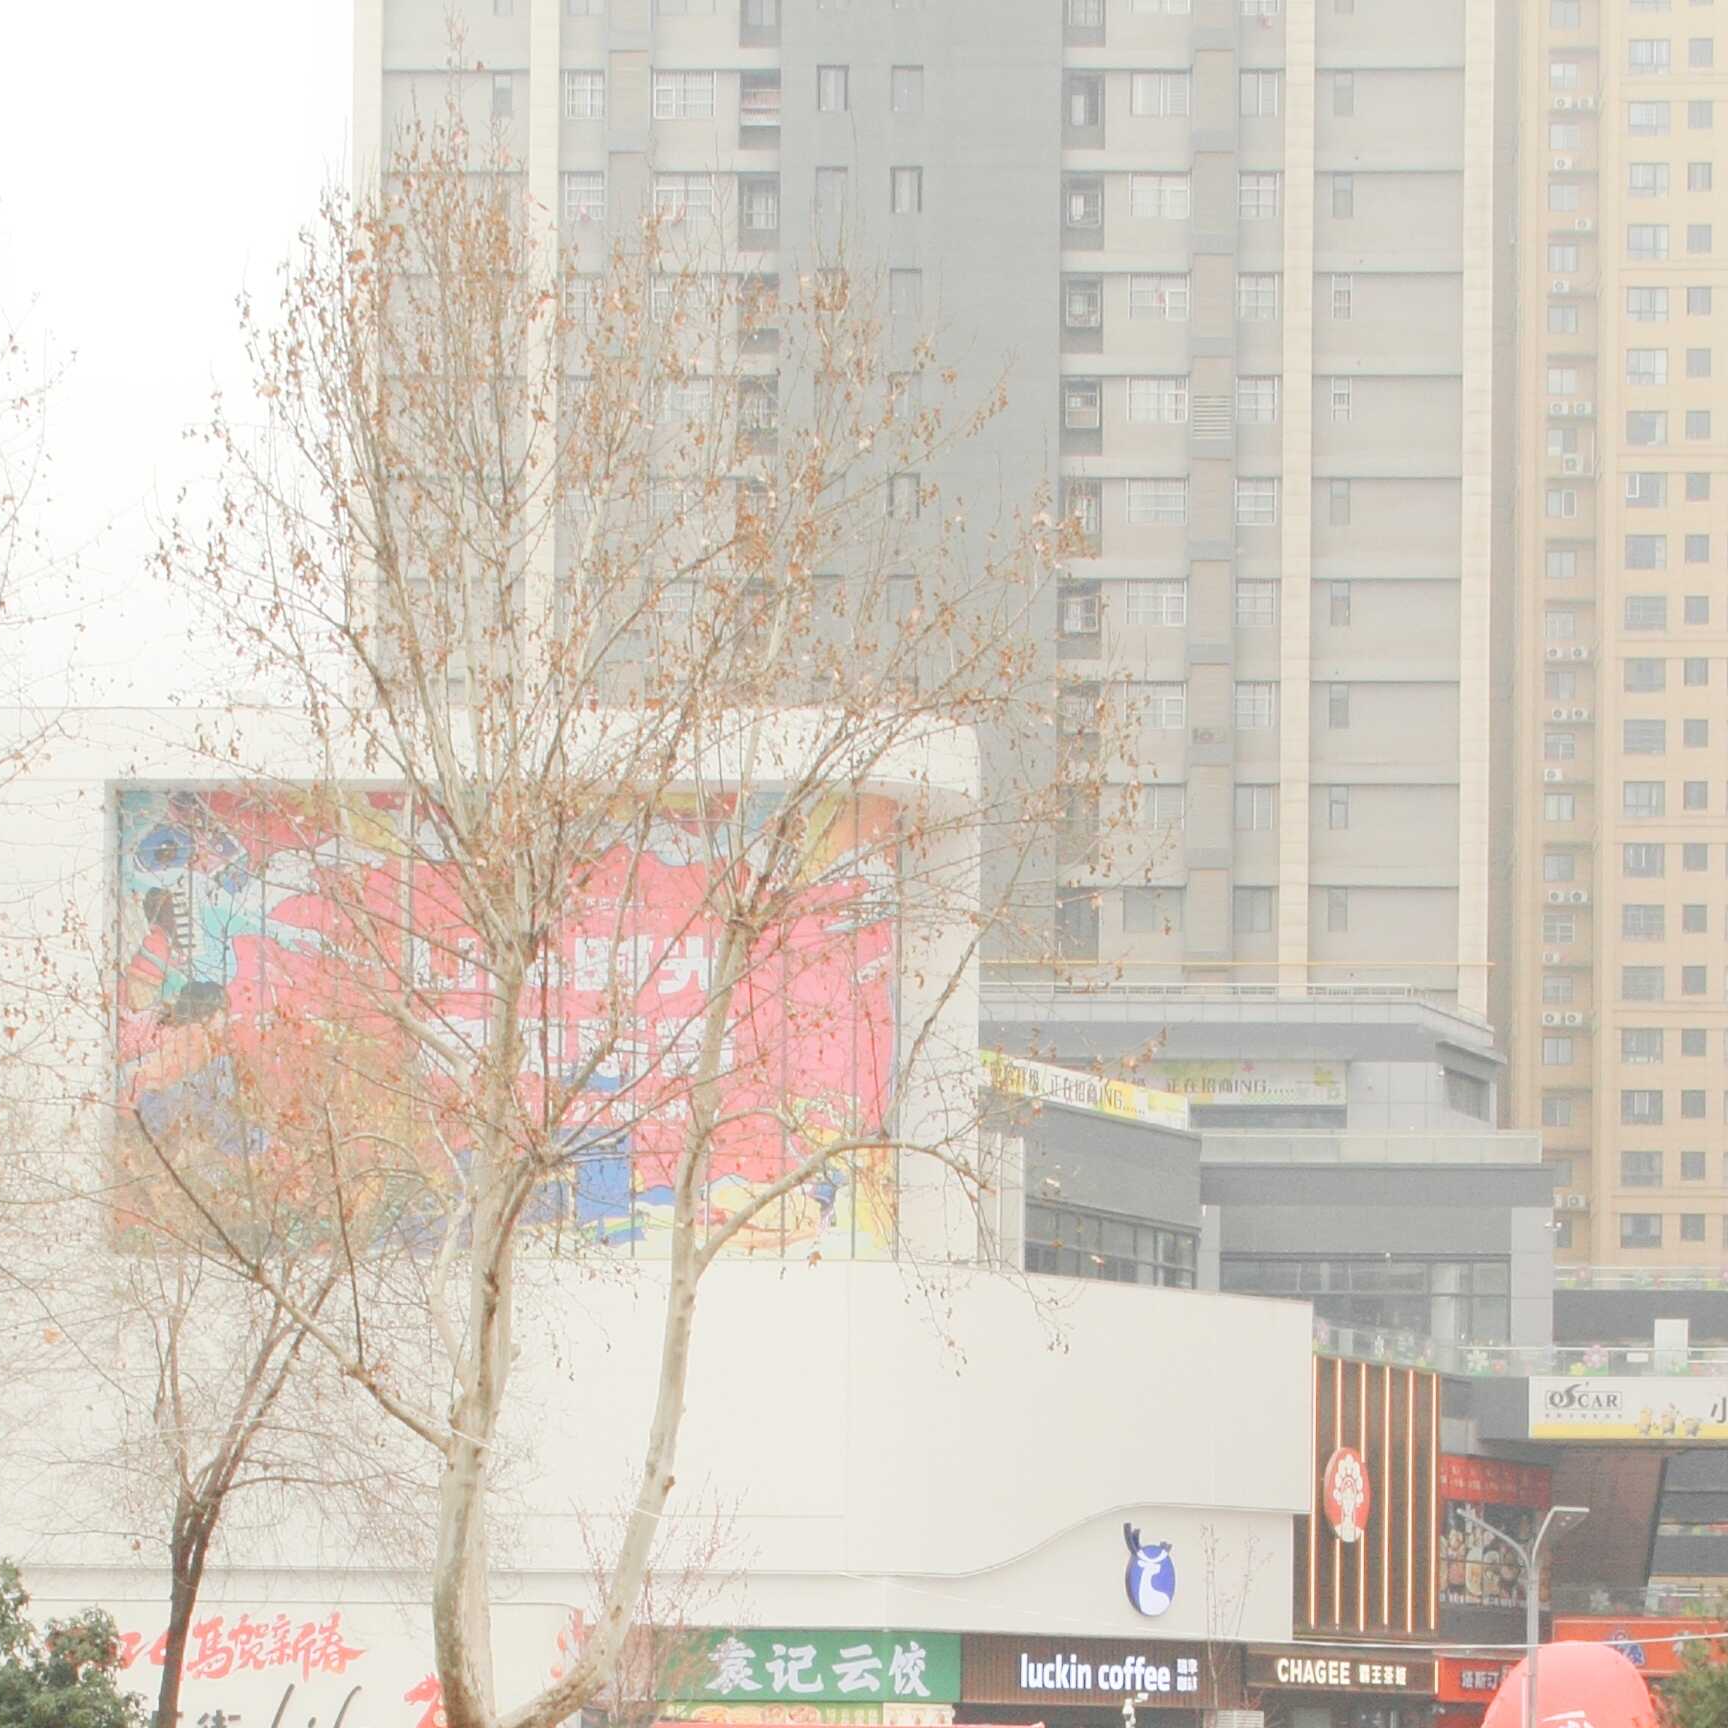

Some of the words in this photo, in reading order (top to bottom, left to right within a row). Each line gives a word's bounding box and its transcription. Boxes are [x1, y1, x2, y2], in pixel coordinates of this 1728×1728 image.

[705, 1637, 931, 1697] 袁记云饺
[1020, 1653, 1092, 1690] luckin
[1098, 1656, 1170, 1692] coffee
[1277, 1658, 1351, 1685] CHAGEE
